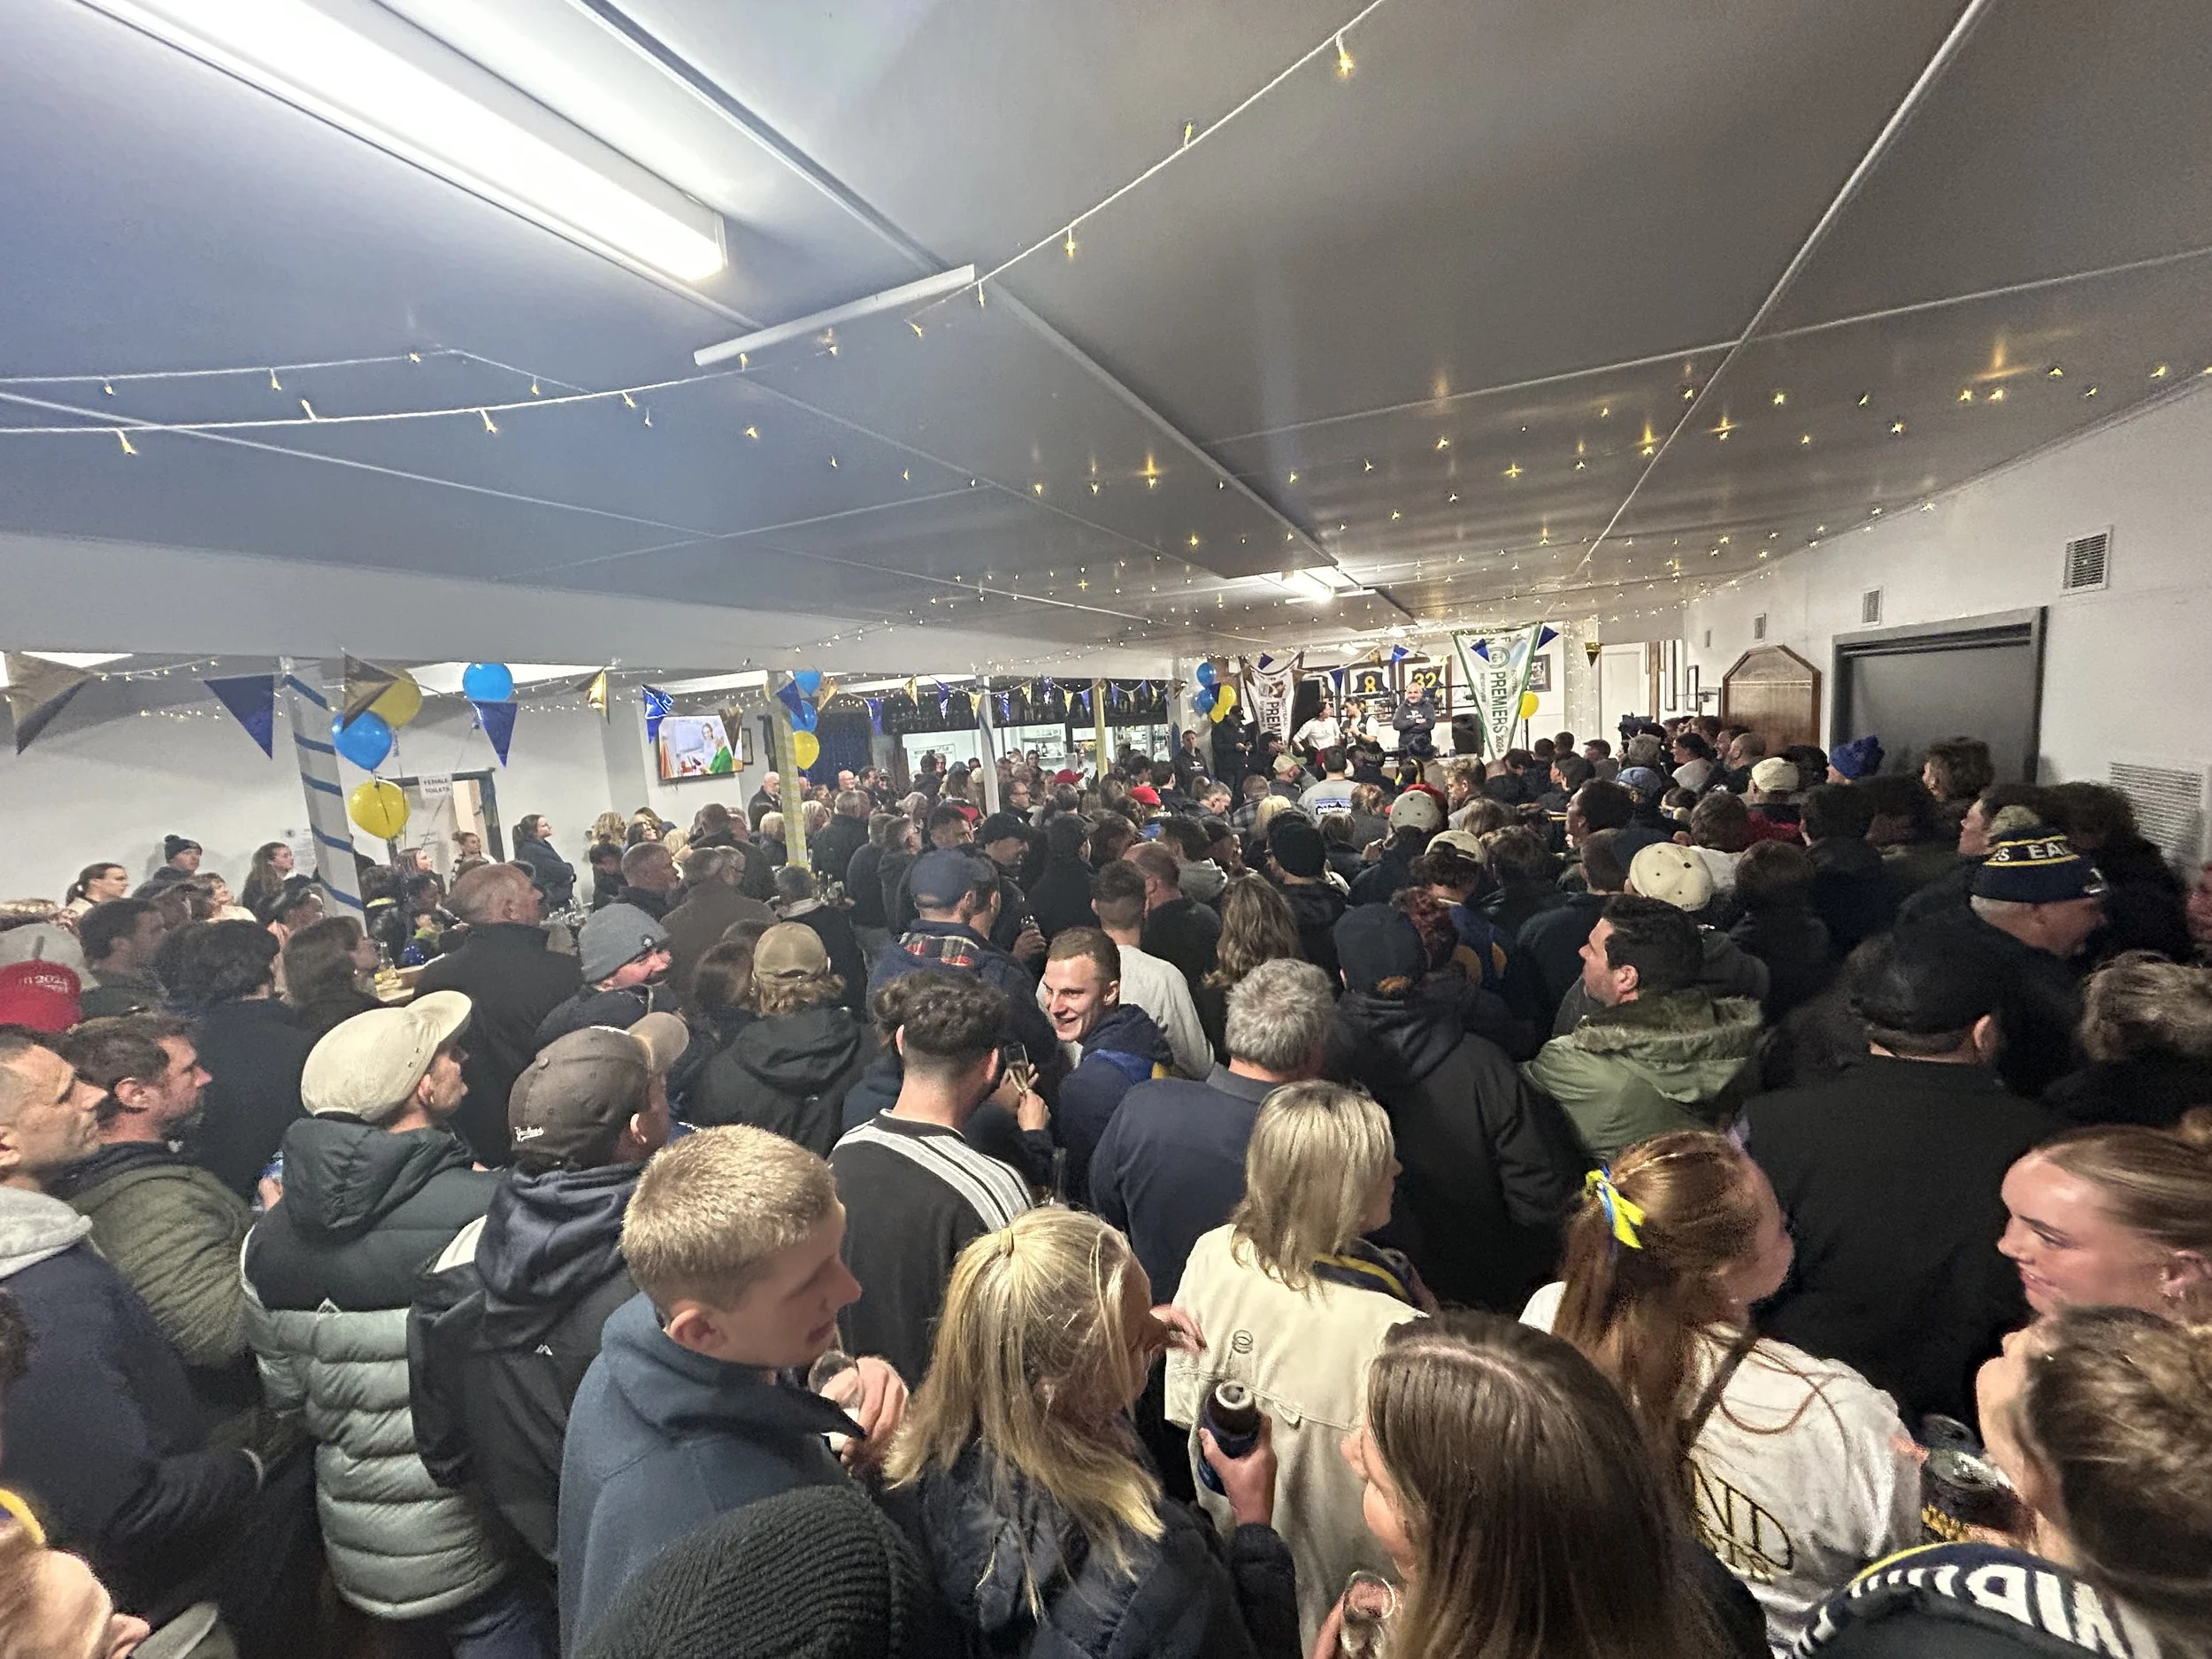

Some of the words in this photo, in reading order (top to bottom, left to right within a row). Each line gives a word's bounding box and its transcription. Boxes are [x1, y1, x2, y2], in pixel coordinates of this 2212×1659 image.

[1364, 675, 1376, 694] 8
[1414, 672, 1437, 688] 32
[1490, 672, 1508, 733] PREMIERS
[1495, 735, 1506, 753] 2024
